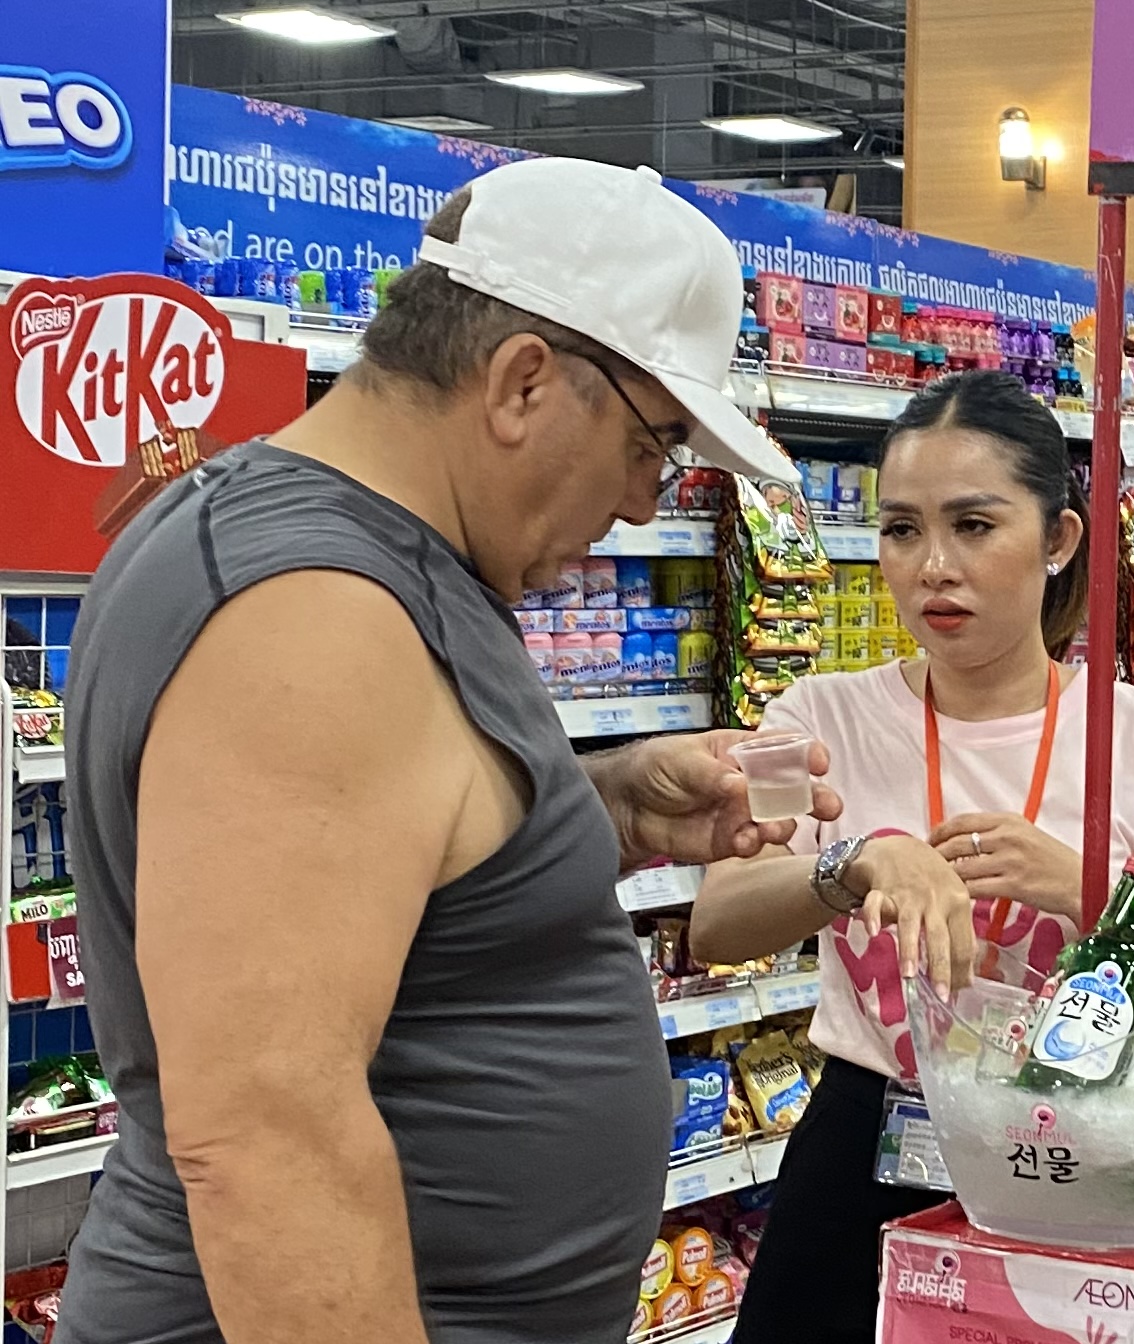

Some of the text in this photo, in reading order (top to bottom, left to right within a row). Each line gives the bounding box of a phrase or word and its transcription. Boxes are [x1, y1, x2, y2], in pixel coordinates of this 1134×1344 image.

[246, 233, 295, 260] are
[304, 241, 344, 270] on
[353, 240, 400, 270] the
[41, 297, 216, 462] KitKat
[21, 904, 48, 922] MILO
[1006, 1125, 1077, 1145] SEONMUL
[1007, 1143, 1079, 1183] 선물
